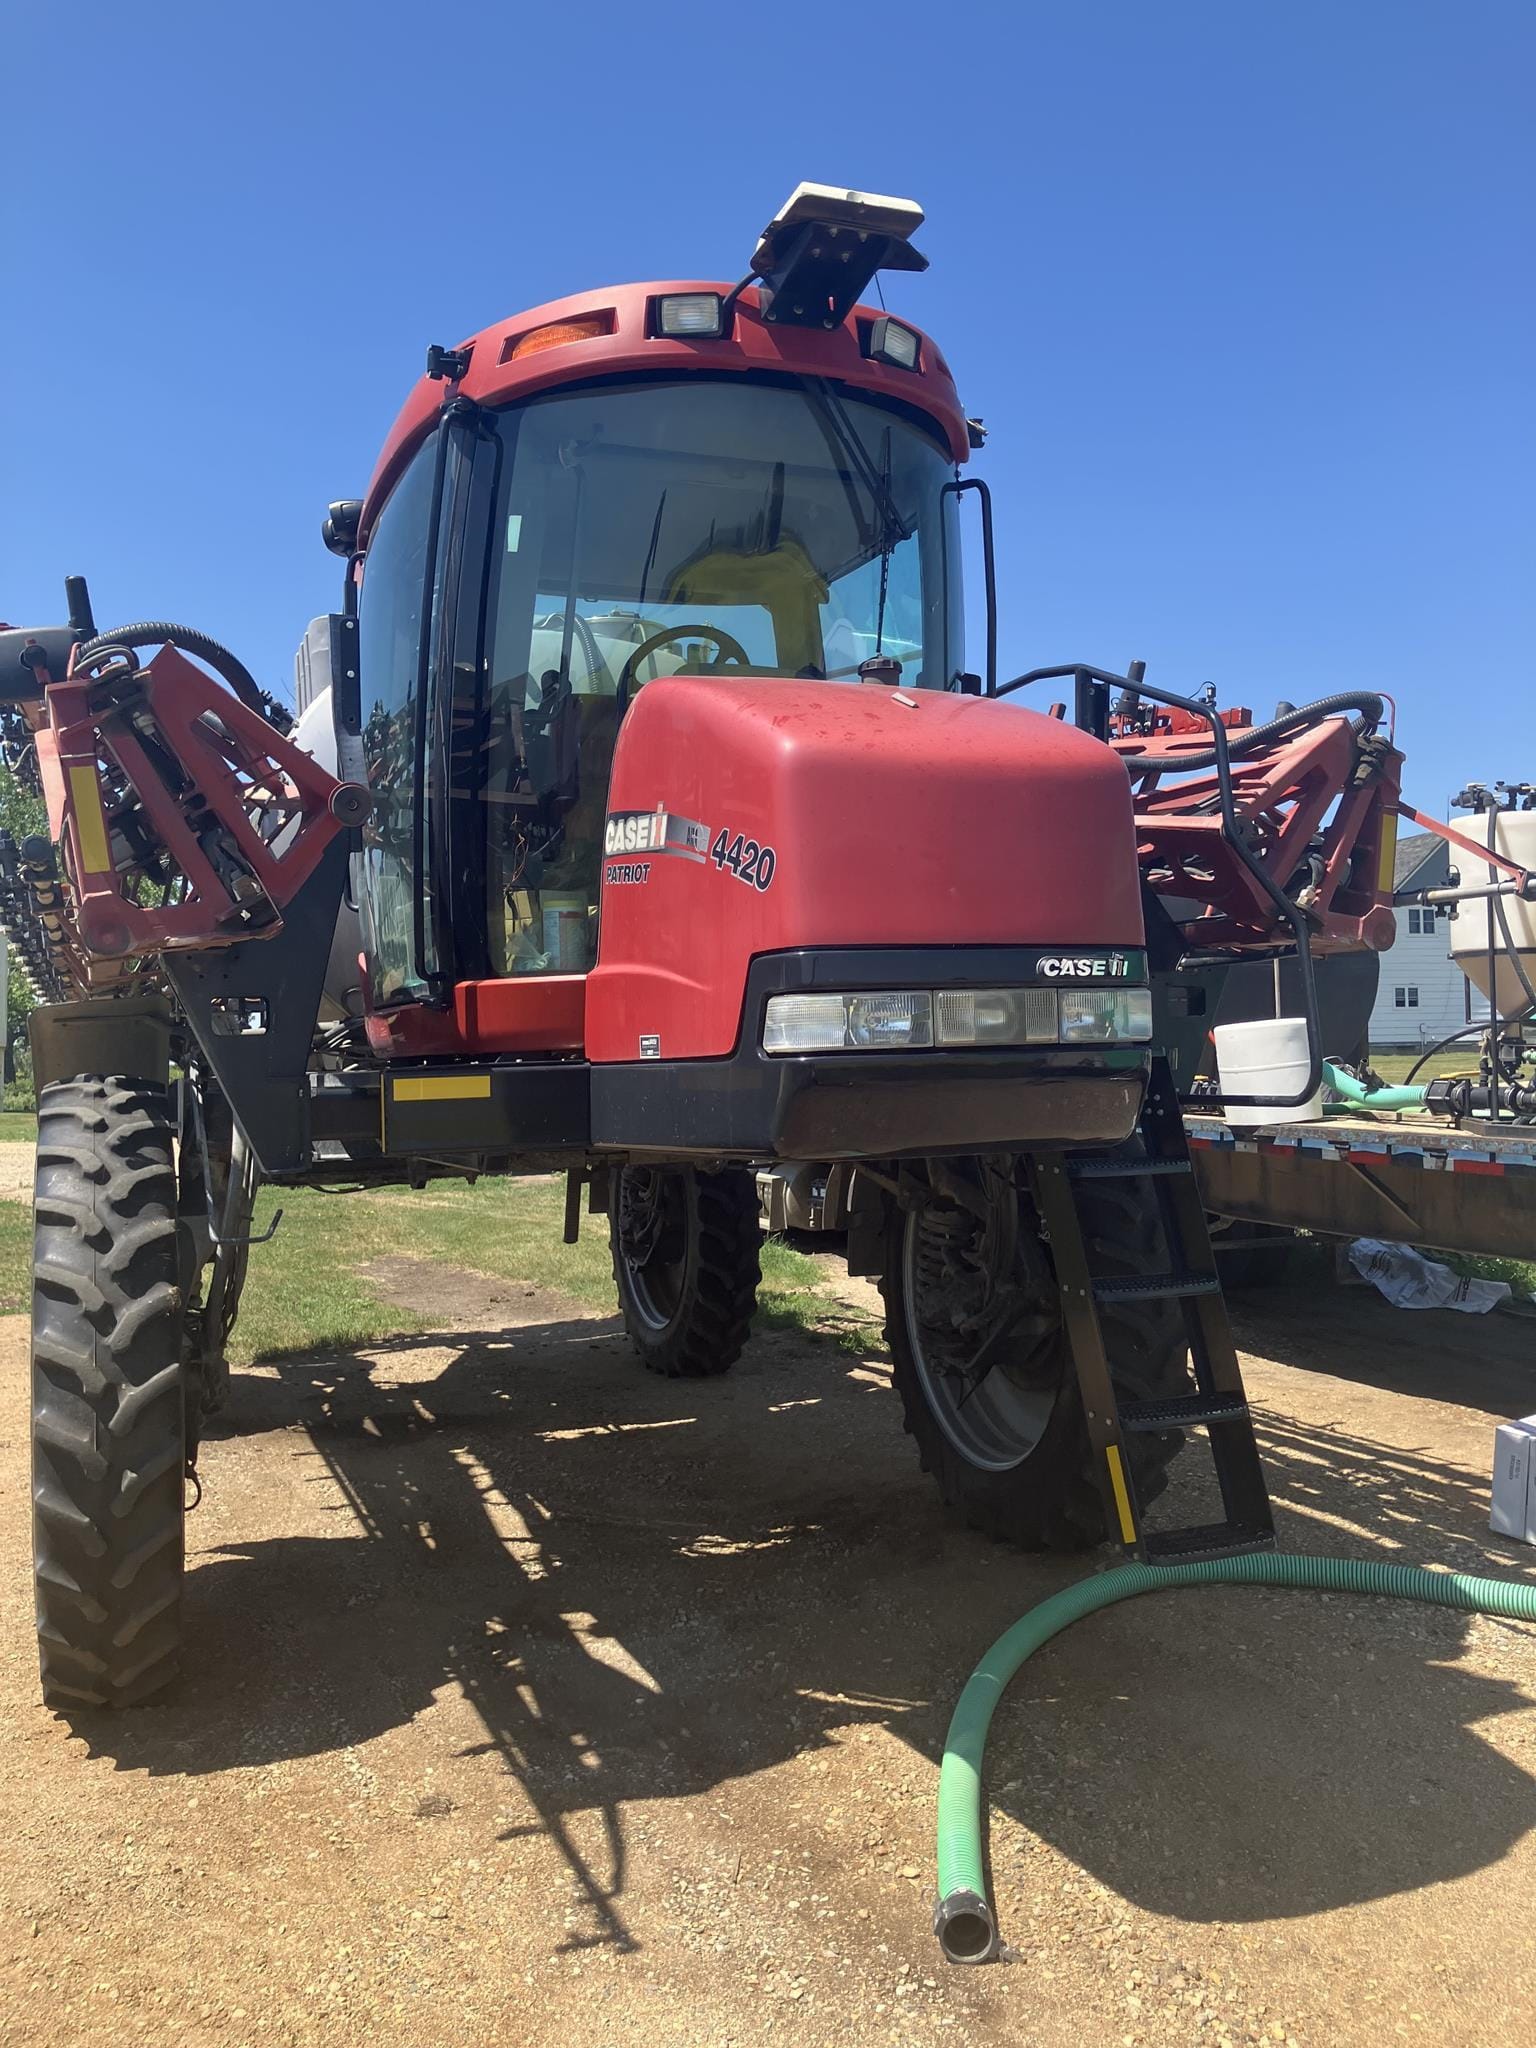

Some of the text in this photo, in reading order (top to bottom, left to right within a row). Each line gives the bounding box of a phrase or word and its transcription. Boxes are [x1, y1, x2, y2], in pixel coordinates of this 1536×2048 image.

[605, 816, 650, 854] CASE
[606, 863, 650, 884] PATRIOT
[711, 828, 776, 892] 4420
[1043, 958, 1107, 977] CASE
